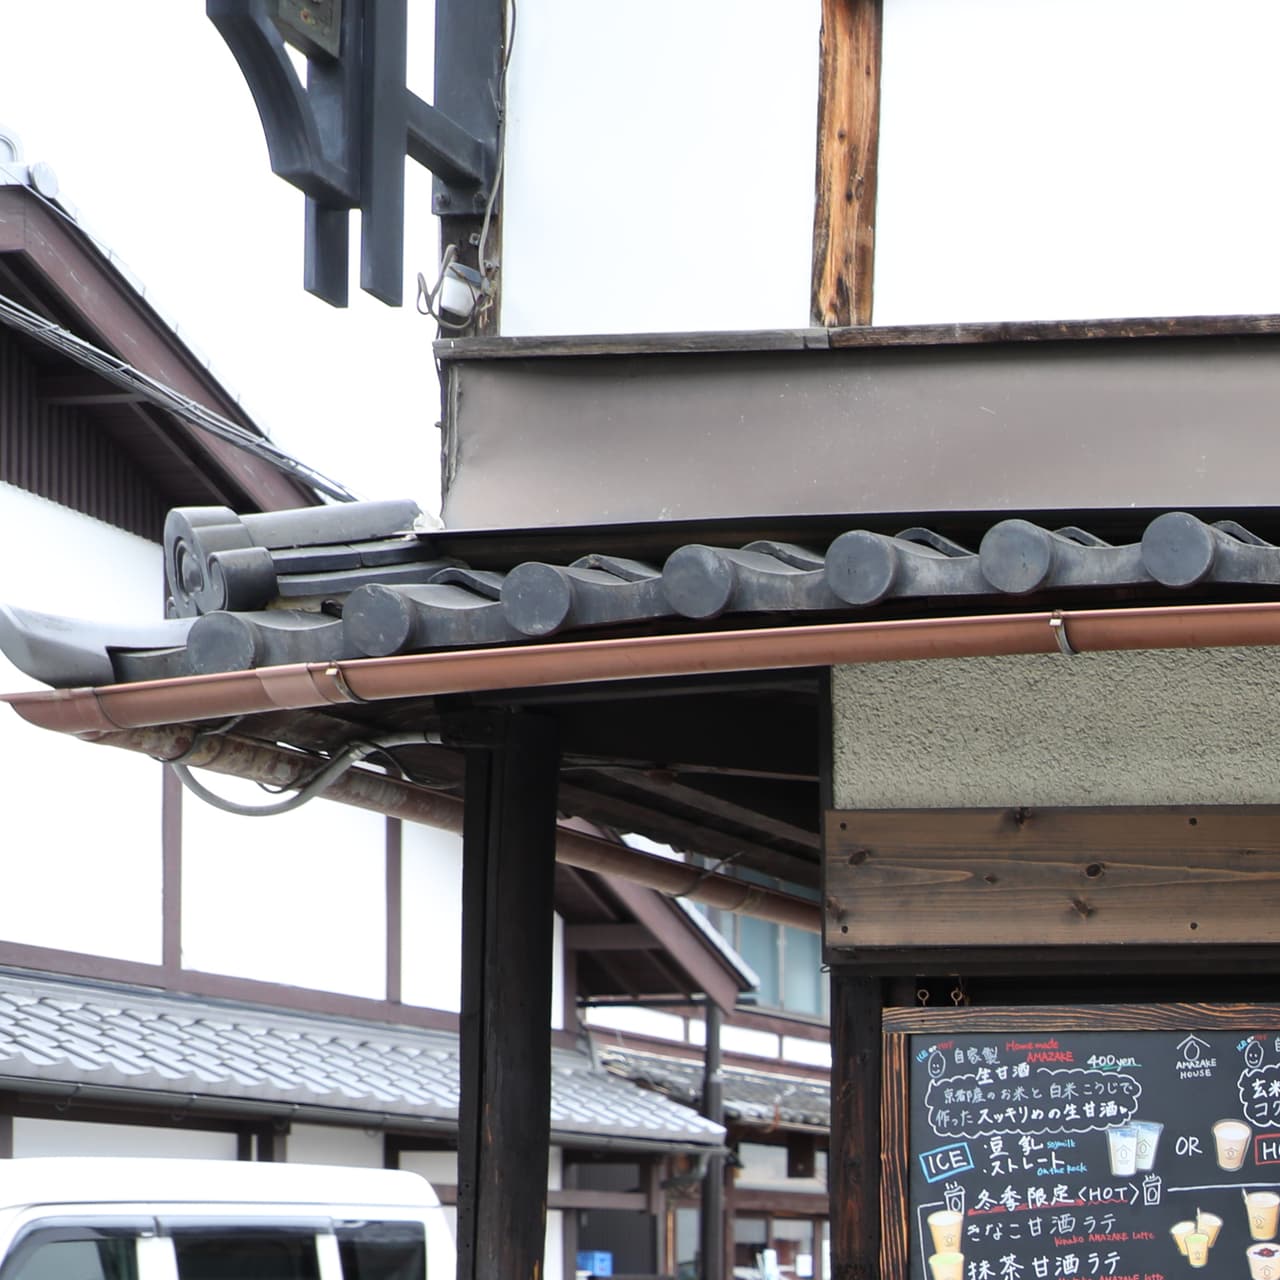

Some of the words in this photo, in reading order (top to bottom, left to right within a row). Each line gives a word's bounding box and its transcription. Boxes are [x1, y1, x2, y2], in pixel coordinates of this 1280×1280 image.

[954, 1047, 1000, 1065] 自家製
[1027, 1050, 1074, 1063] AMAZAKE
[1087, 1055, 1137, 1071] 400yen
[1176, 1058, 1217, 1070] AMAZAKE
[976, 1062, 1030, 1085] 生甘酒
[1180, 1069, 1212, 1079] HOUSE
[1175, 1137, 1203, 1156] OR
[927, 1150, 967, 1175] ICE
[967, 1213, 1117, 1242] きなこ甘酒ラテ
[1088, 1232, 1129, 1243] AMAZAKE
